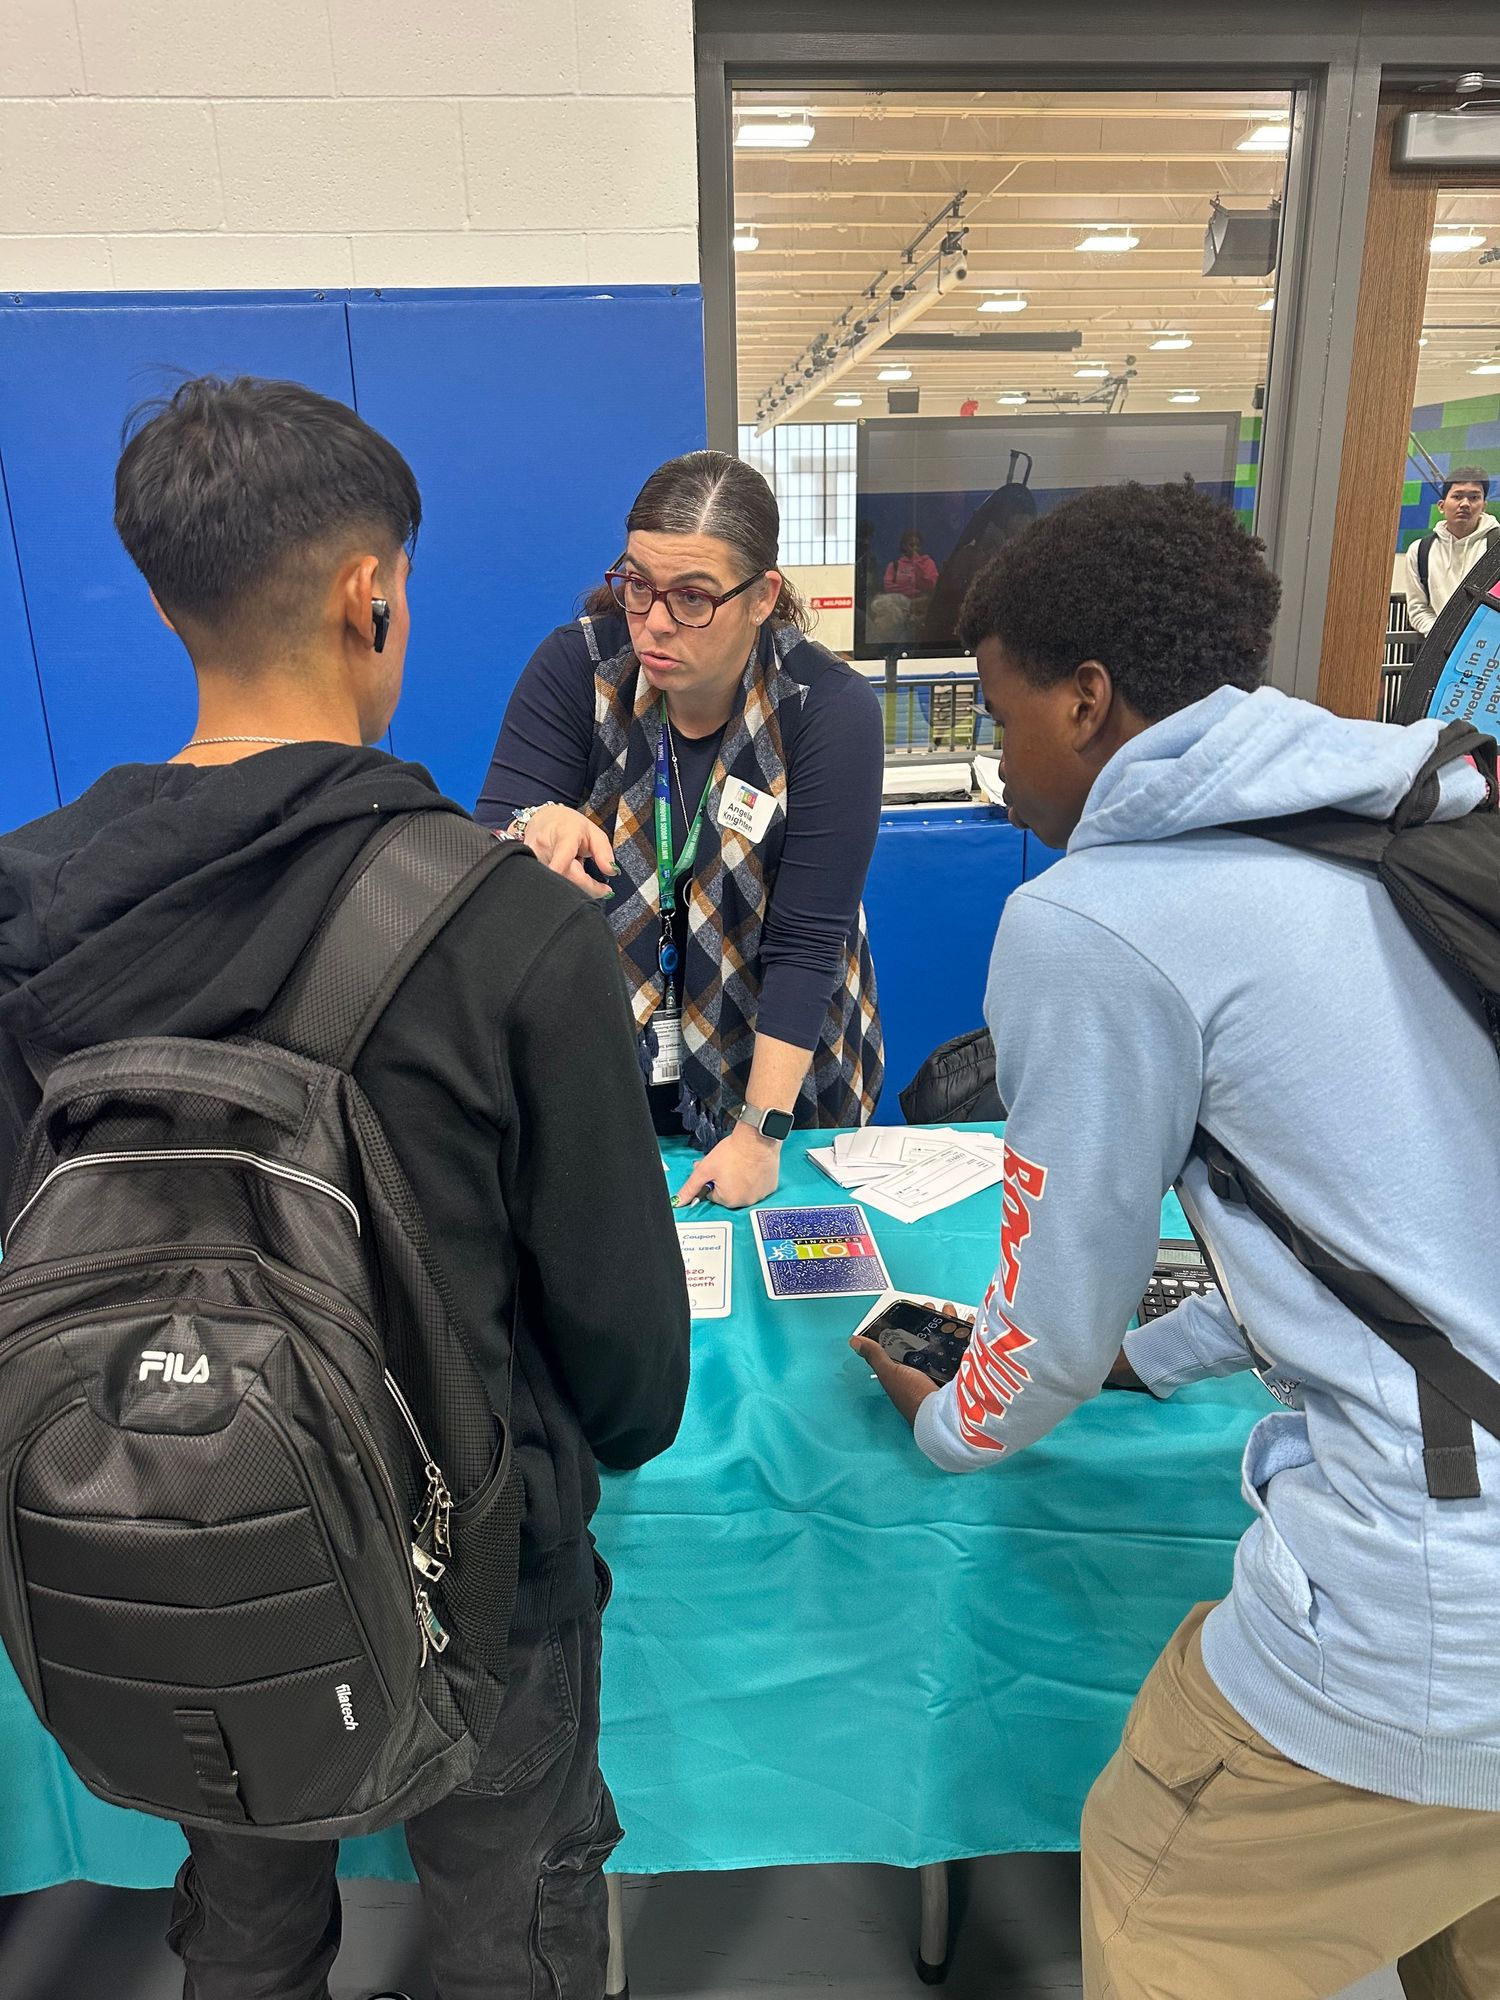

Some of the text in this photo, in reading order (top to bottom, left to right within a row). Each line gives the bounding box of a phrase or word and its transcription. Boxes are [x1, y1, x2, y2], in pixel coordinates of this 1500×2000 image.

[1442, 639, 1487, 715] You're in a
[727, 803, 753, 821] Angela
[796, 1237, 861, 1245] FINANCES
[801, 1241, 867, 1259] 101
[139, 1350, 210, 1384] FILA
[335, 1683, 359, 1731] filatech
